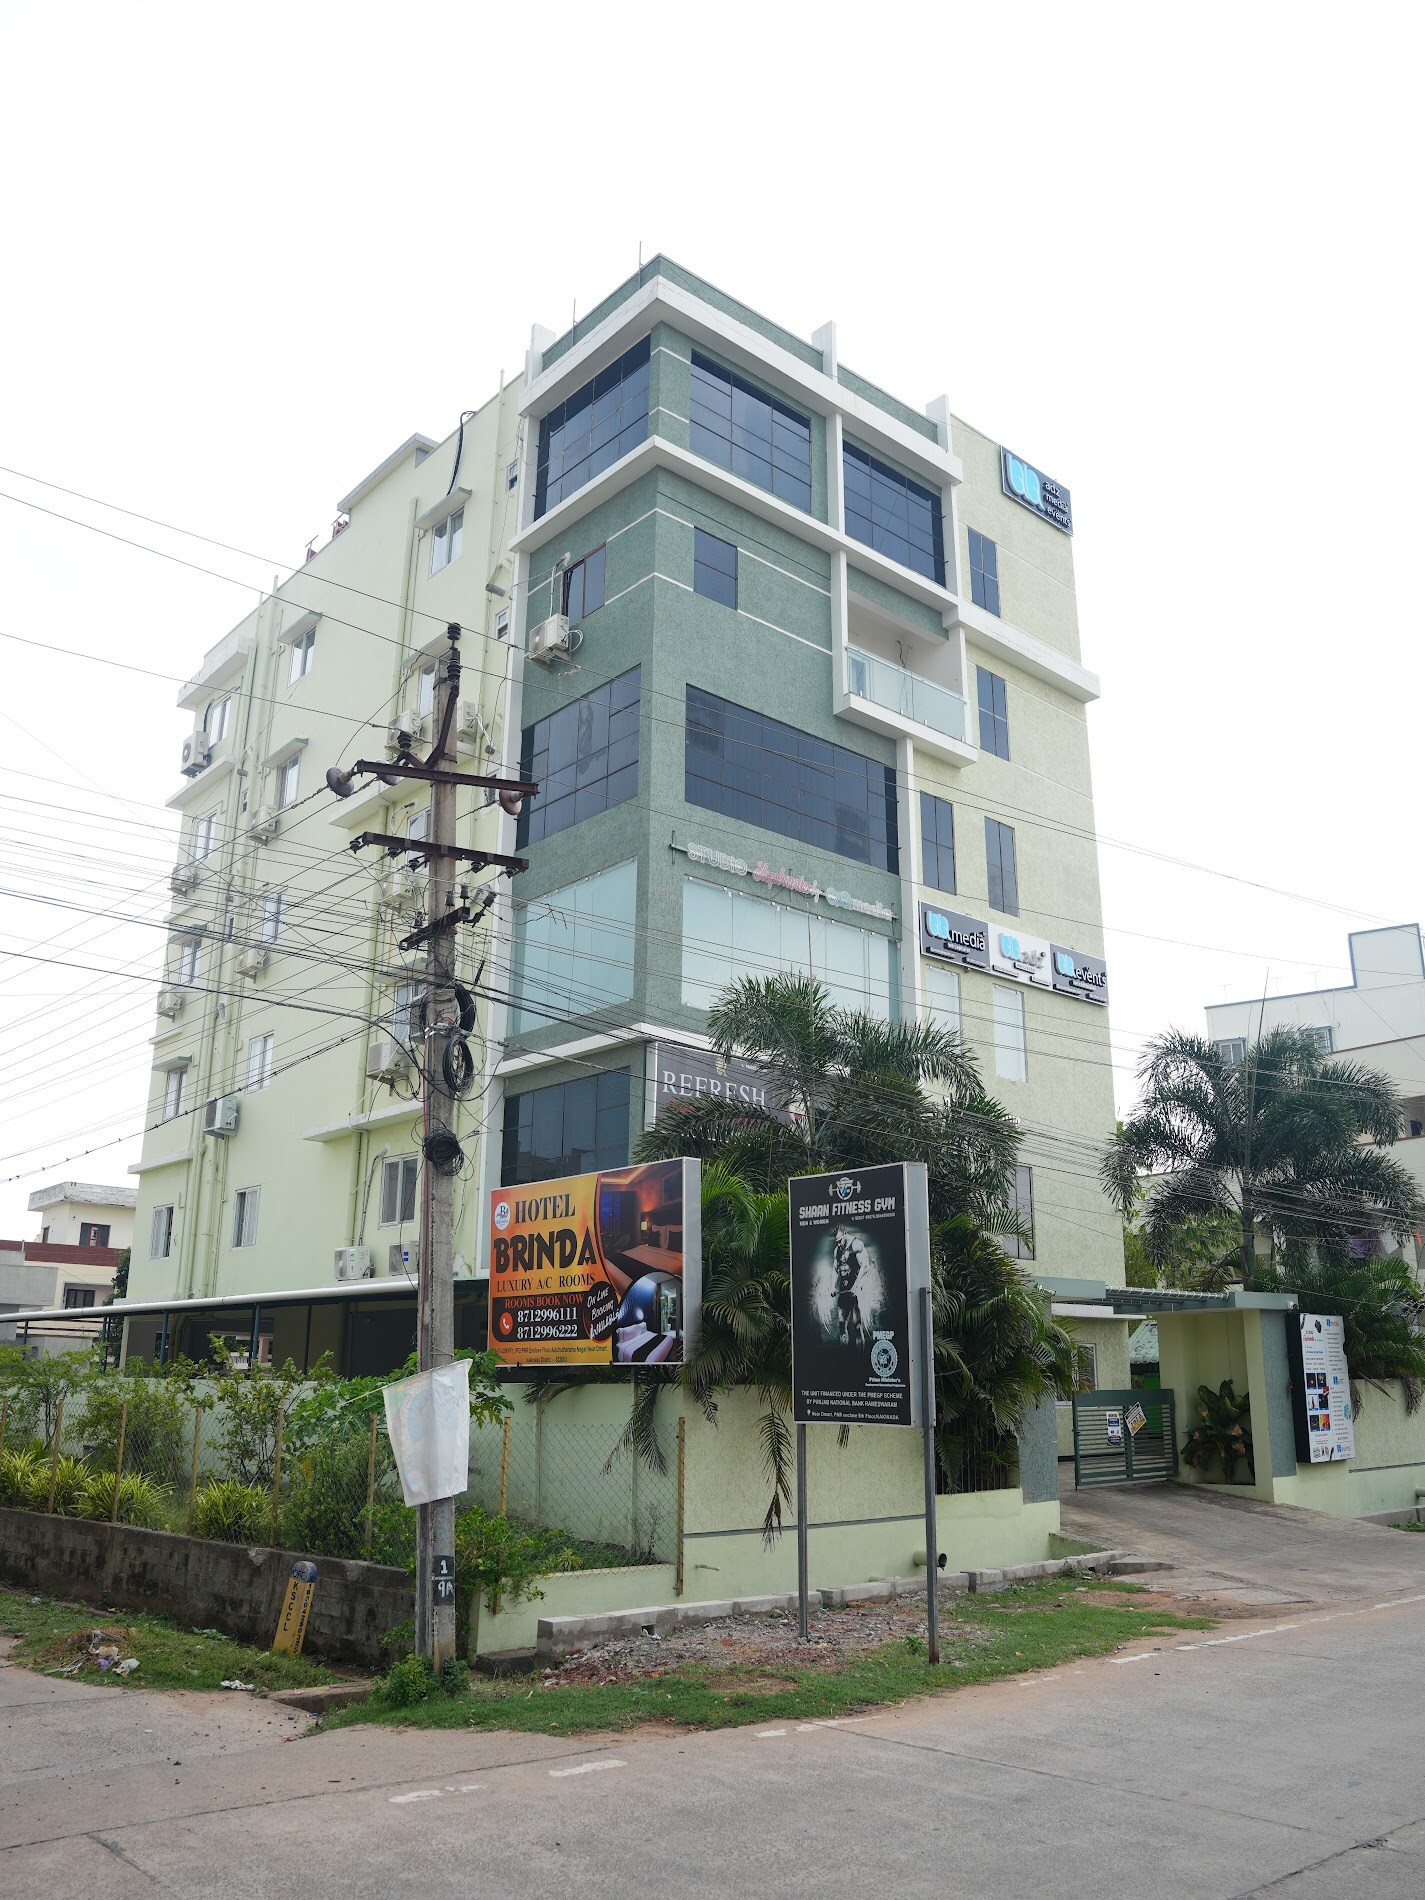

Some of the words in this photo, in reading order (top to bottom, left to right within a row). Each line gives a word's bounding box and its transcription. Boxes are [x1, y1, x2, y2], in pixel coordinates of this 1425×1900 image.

[1046, 493, 1069, 513] media
[1047, 506, 1071, 527] events
[687, 842, 748, 876] STUDIO
[951, 929, 986, 951] media
[1075, 968, 1107, 987] events
[662, 1070, 767, 1110] REFRESH
[514, 1193, 576, 1224] HOTEL
[799, 1204, 829, 1219] SHAAN
[832, 1199, 871, 1216] FITNESS
[874, 1197, 896, 1212] GYM
[493, 1225, 597, 1273] BRINDA
[496, 1278, 533, 1293] LUXURY
[536, 1276, 553, 1290] A/C
[559, 1273, 595, 1288] ROOMS
[505, 1297, 535, 1309] ROOMS
[536, 1295, 561, 1307] BOOK
[562, 1294, 584, 1306] NOW
[517, 1307, 578, 1323] 8712996111
[517, 1324, 578, 1340] 8712996222
[440, 1559, 448, 1574] 1
